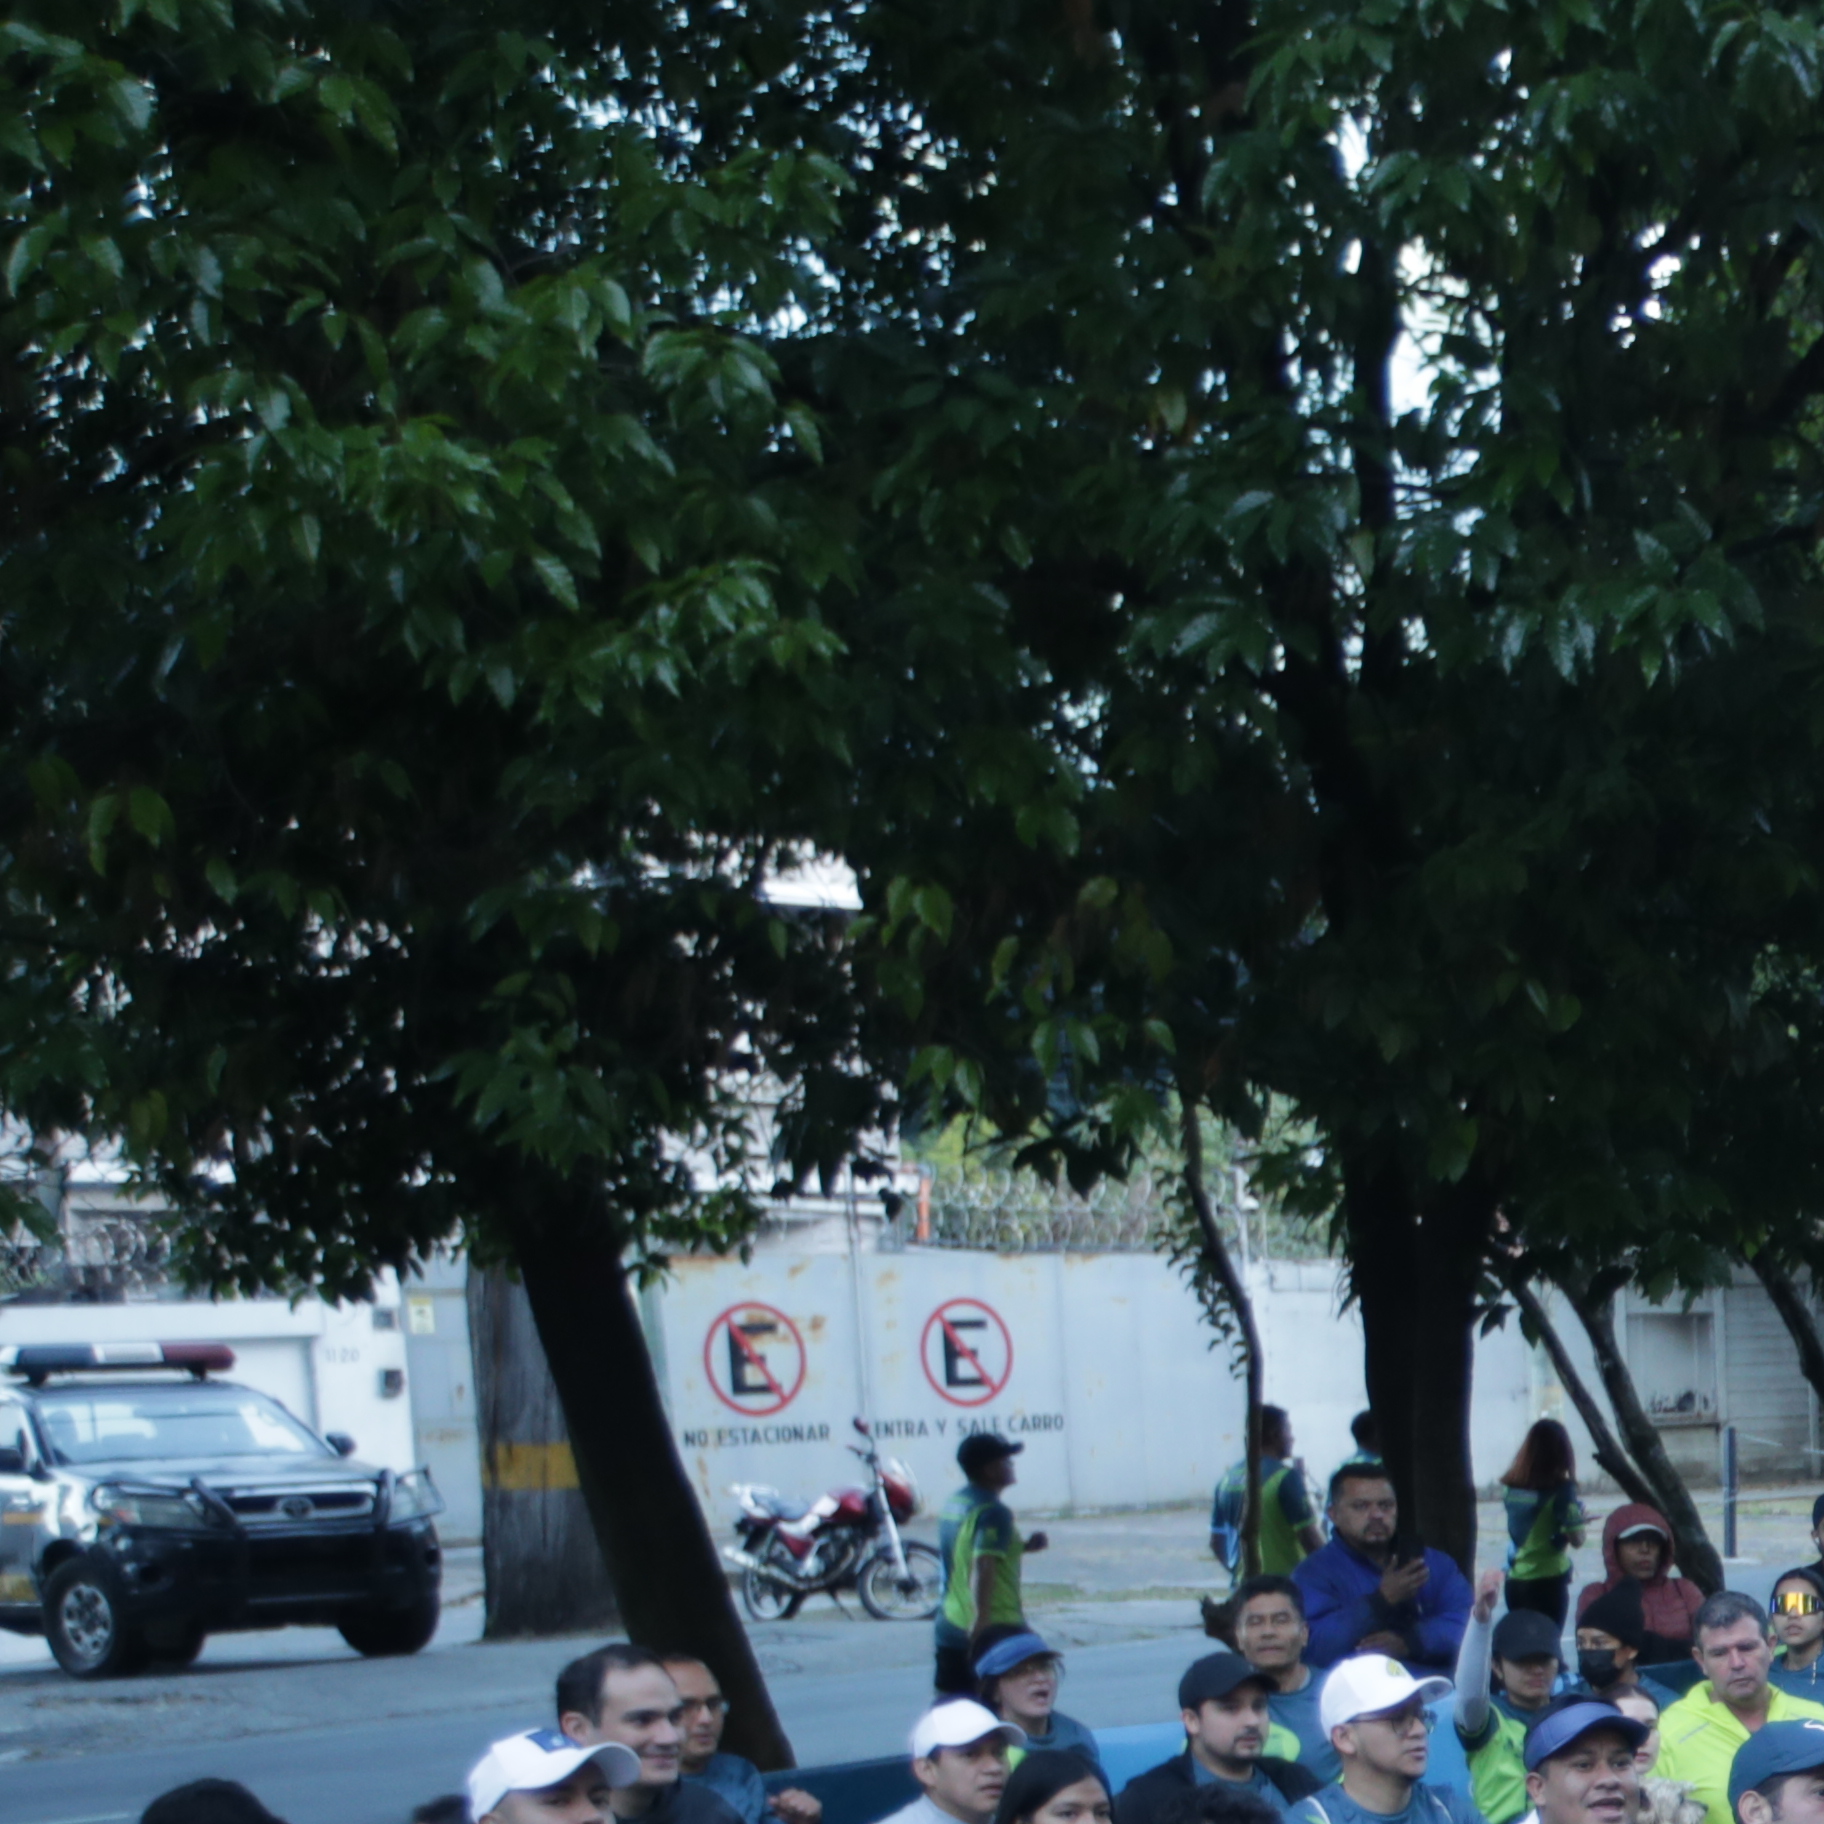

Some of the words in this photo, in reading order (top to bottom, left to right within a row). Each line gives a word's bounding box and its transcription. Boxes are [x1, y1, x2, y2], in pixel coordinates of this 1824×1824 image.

[726, 1322, 782, 1396] E
[941, 1319, 987, 1387] E
[684, 1430, 708, 1448] NO
[716, 1424, 831, 1446] ESTACIONAR
[874, 1419, 929, 1439] ENTRA
[937, 1419, 948, 1437] Y
[956, 1417, 1000, 1436] SALE
[1007, 1414, 1065, 1434] CARRO
